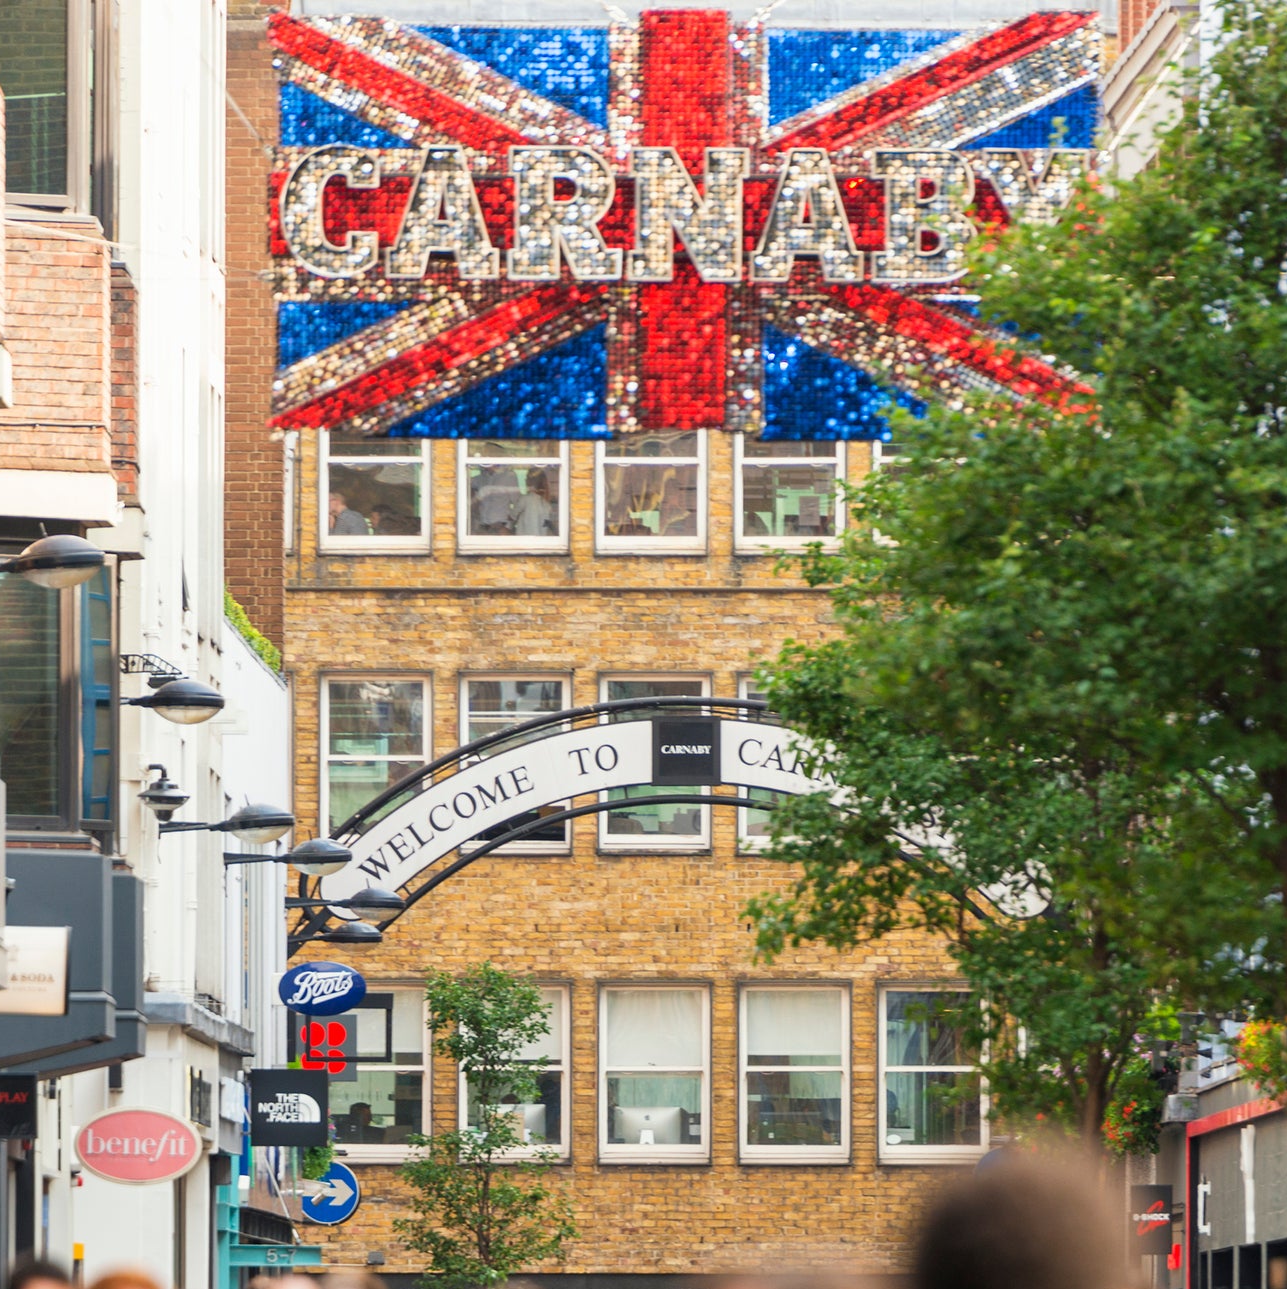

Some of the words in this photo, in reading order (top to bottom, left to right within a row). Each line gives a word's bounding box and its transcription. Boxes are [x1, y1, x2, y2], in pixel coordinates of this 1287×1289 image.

[279, 142, 1090, 284] CARNABY
[660, 744, 712, 755] CARNABY
[357, 765, 535, 882] WELCOME
[567, 743, 619, 777] TO
[287, 970, 354, 1005] Boots
[257, 1102, 299, 1113] NORTH
[275, 1093, 299, 1103] THE
[85, 1127, 191, 1164] benefit
[265, 1248, 297, 1263] 5-7
